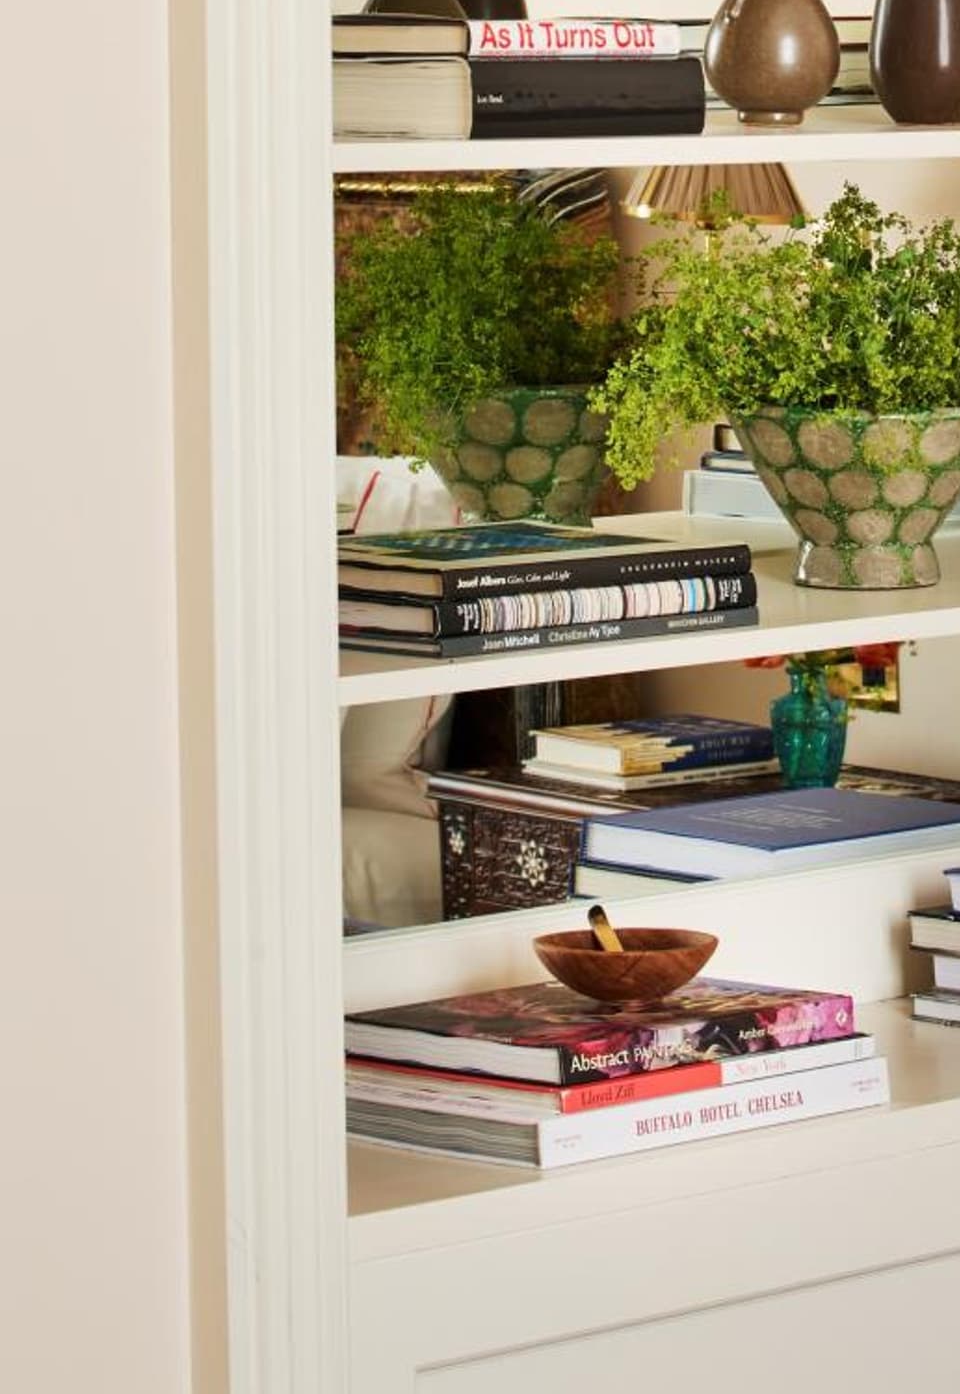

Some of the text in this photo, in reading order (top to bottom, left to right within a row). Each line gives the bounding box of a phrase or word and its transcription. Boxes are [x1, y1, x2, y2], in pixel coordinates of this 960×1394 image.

[480, 21, 656, 49] As It Turns Out
[504, 633, 540, 648] Mitchell
[570, 1051, 631, 1075] Abstract
[635, 1090, 804, 1137] BUFFALO HOTEL CHELSEA
